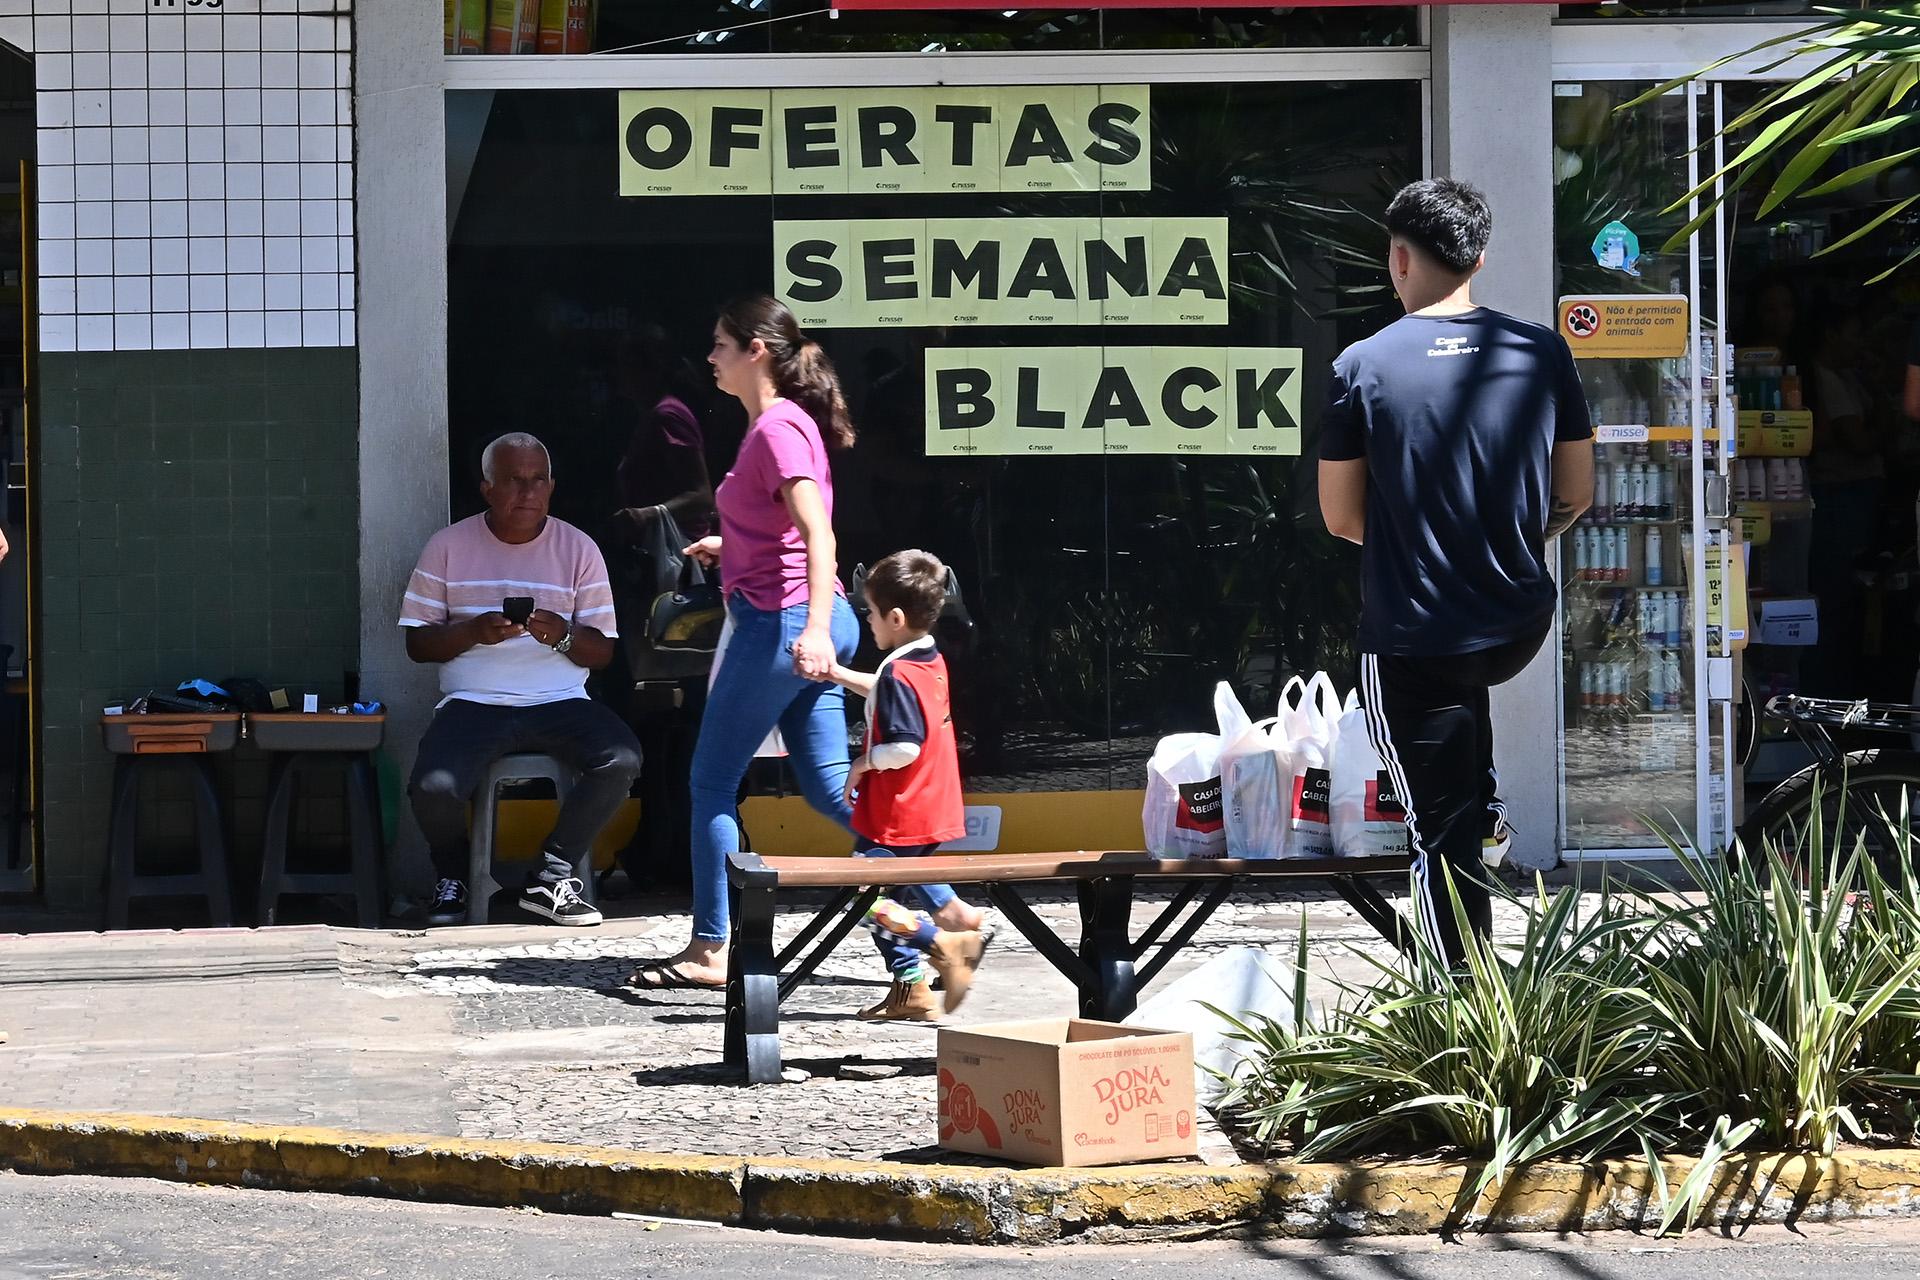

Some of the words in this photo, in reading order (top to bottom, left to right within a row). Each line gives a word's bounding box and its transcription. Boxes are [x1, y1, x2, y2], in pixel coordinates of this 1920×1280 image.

[625, 101, 1142, 171] OFERTAS
[785, 235, 1228, 303] SEMANA
[1606, 305, 1625, 315] Não
[1628, 305, 1634, 315] é
[1615, 316, 1652, 325] entrada
[1654, 317, 1675, 325] com
[1606, 326, 1644, 336] animais
[935, 365, 1299, 431] BLACK
[1611, 428, 1645, 437] nissei
[1193, 790, 1213, 801] CASA
[1302, 790, 1328, 803] CABEL
[1378, 793, 1399, 802] CAB
[1189, 800, 1223, 814] ABELEIR
[1092, 1065, 1170, 1103] DONA
[1003, 1089, 1045, 1113] DONA
[1105, 1086, 1164, 1126] JURA
[1009, 1107, 1042, 1135] JURA
